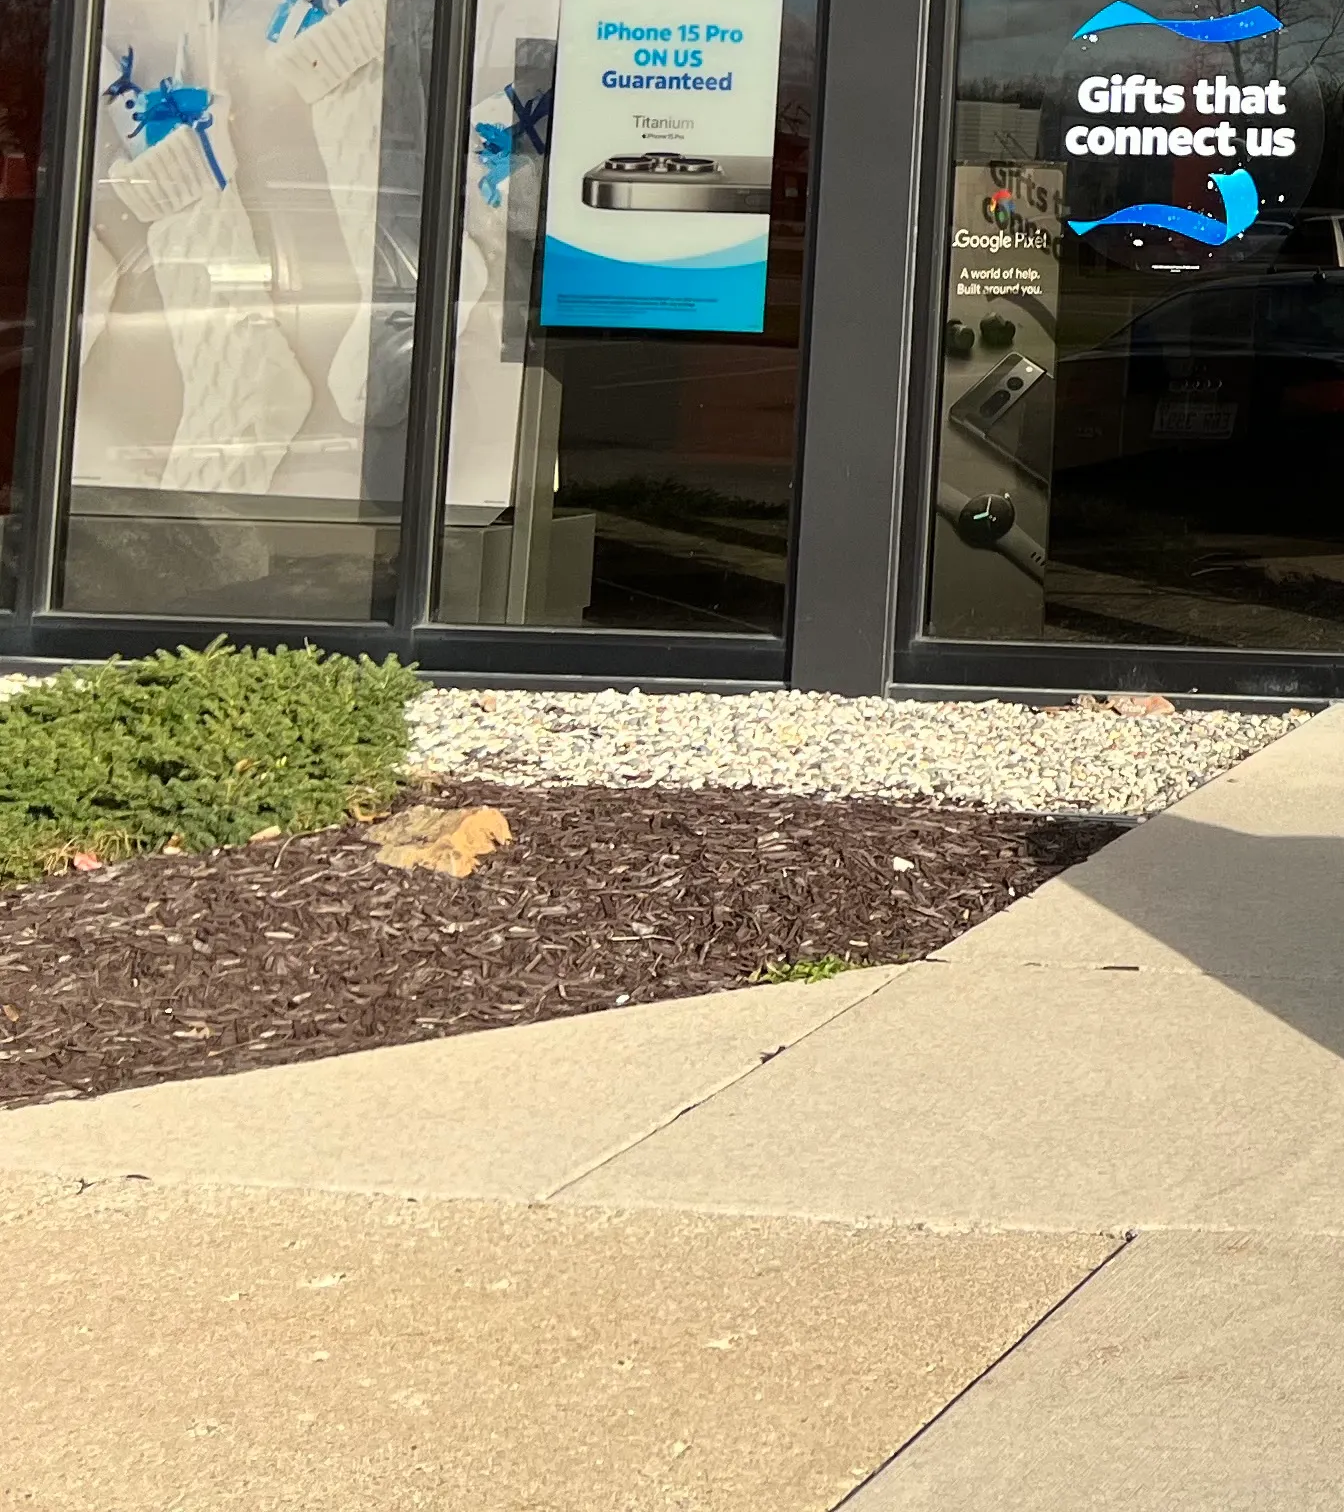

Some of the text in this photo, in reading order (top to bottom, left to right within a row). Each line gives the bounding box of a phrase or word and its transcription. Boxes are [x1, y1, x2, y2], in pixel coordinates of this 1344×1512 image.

[597, 21, 744, 44] iPhone 15 Pro
[633, 48, 703, 68] ON US
[602, 70, 733, 91] Guaranteed
[1077, 74, 1287, 115] Gifts that
[632, 114, 695, 130] Titanium
[1065, 121, 1297, 157] connect us
[954, 228, 1047, 253] Google Pixel
[960, 267, 1041, 282] A world of help.
[957, 283, 1042, 296] Built around you.
